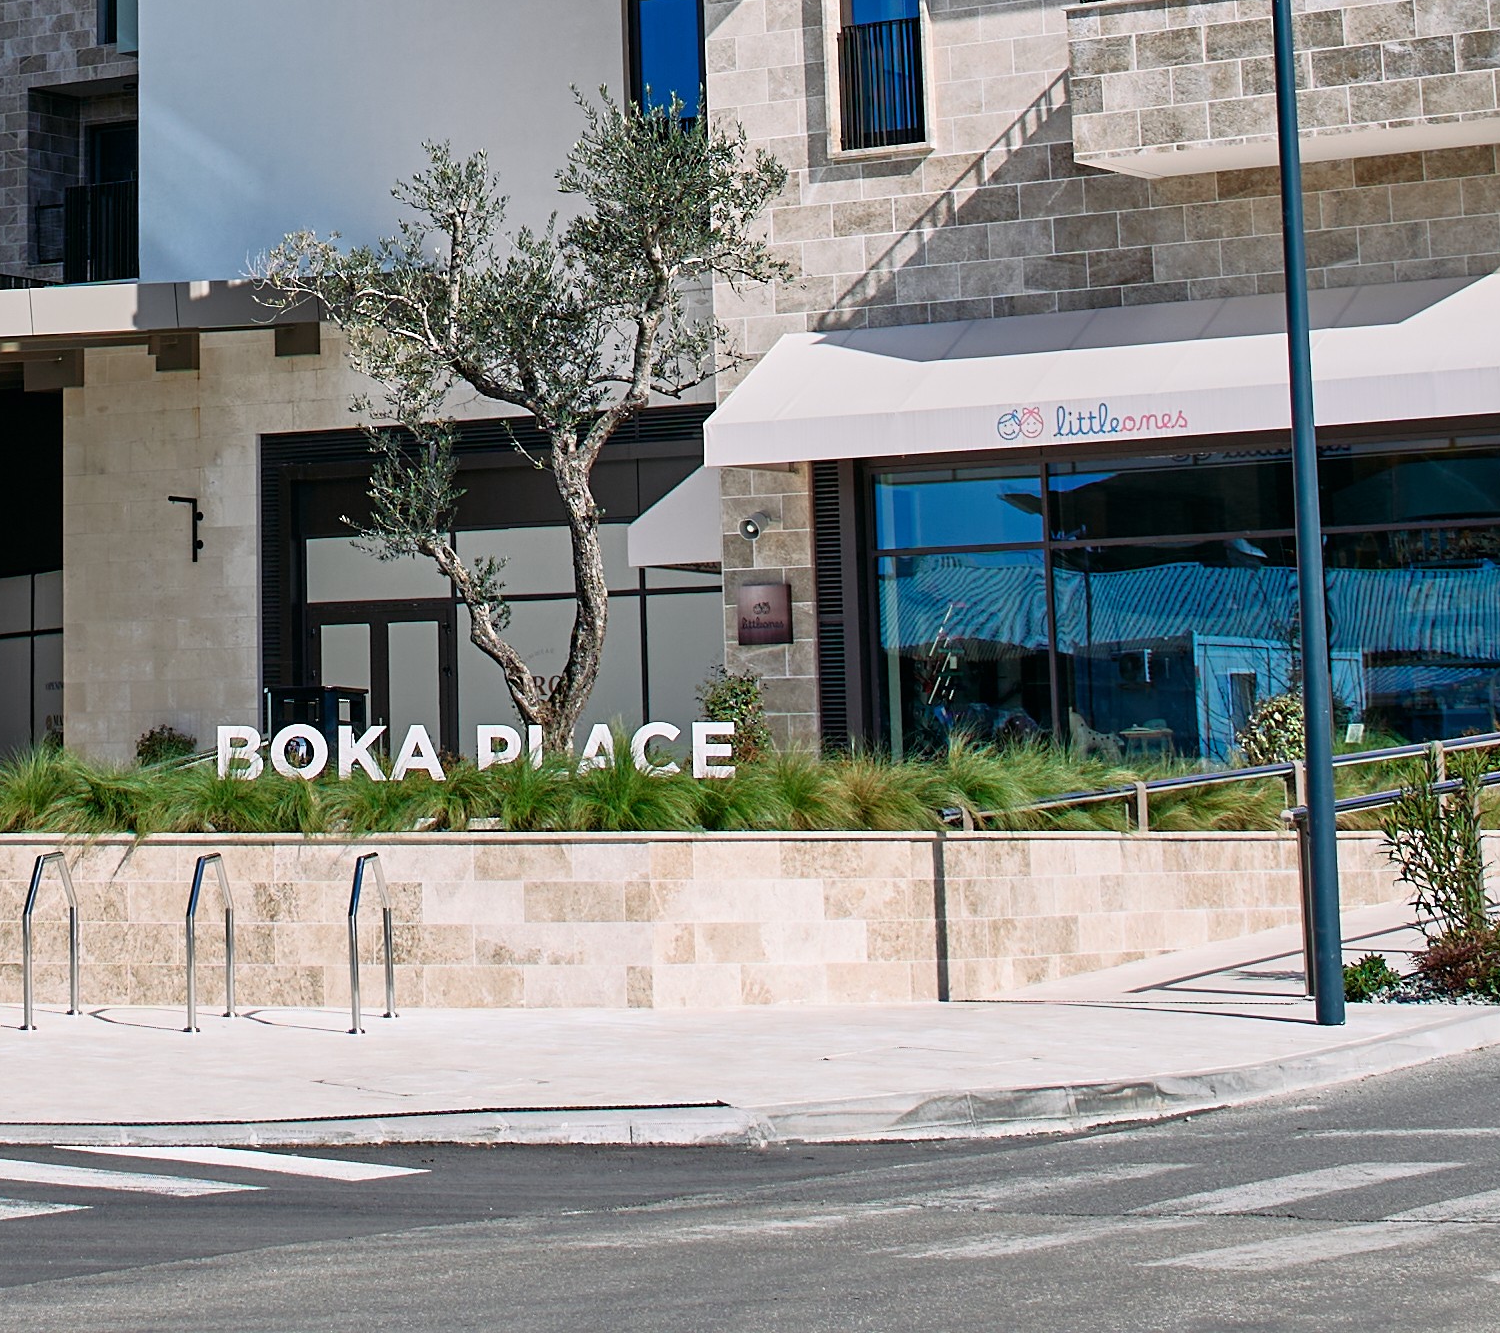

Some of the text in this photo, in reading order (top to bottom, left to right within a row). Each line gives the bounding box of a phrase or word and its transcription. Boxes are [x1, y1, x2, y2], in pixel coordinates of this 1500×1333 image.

[1053, 402, 1189, 437] littleones
[216, 721, 737, 782] BOKA PLACE
